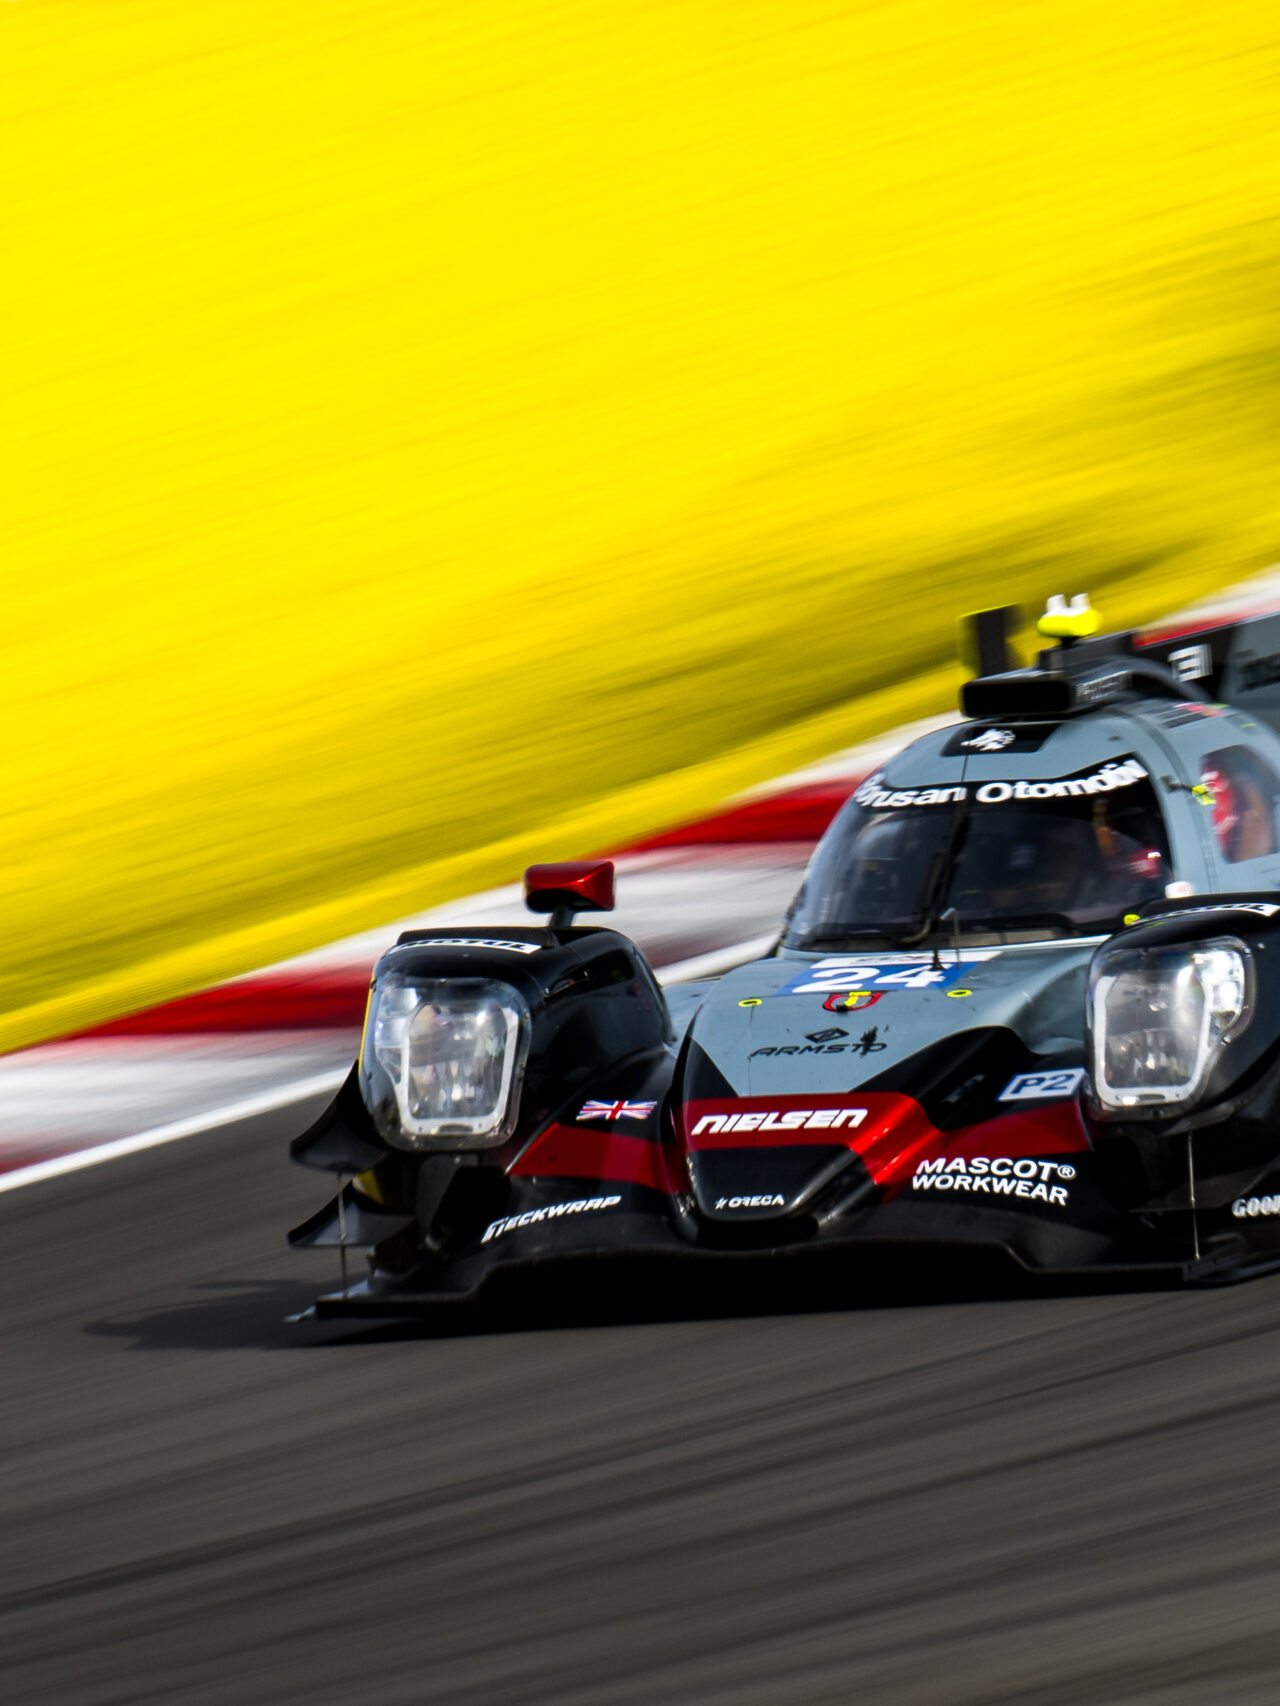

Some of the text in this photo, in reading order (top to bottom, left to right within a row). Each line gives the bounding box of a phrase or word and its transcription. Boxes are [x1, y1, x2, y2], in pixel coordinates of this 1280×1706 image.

[792, 964, 953, 993] 24
[1010, 1073, 1075, 1095] P2
[691, 1108, 868, 1136] NIELSEN
[912, 1174, 1069, 1206] WORKWEAR
